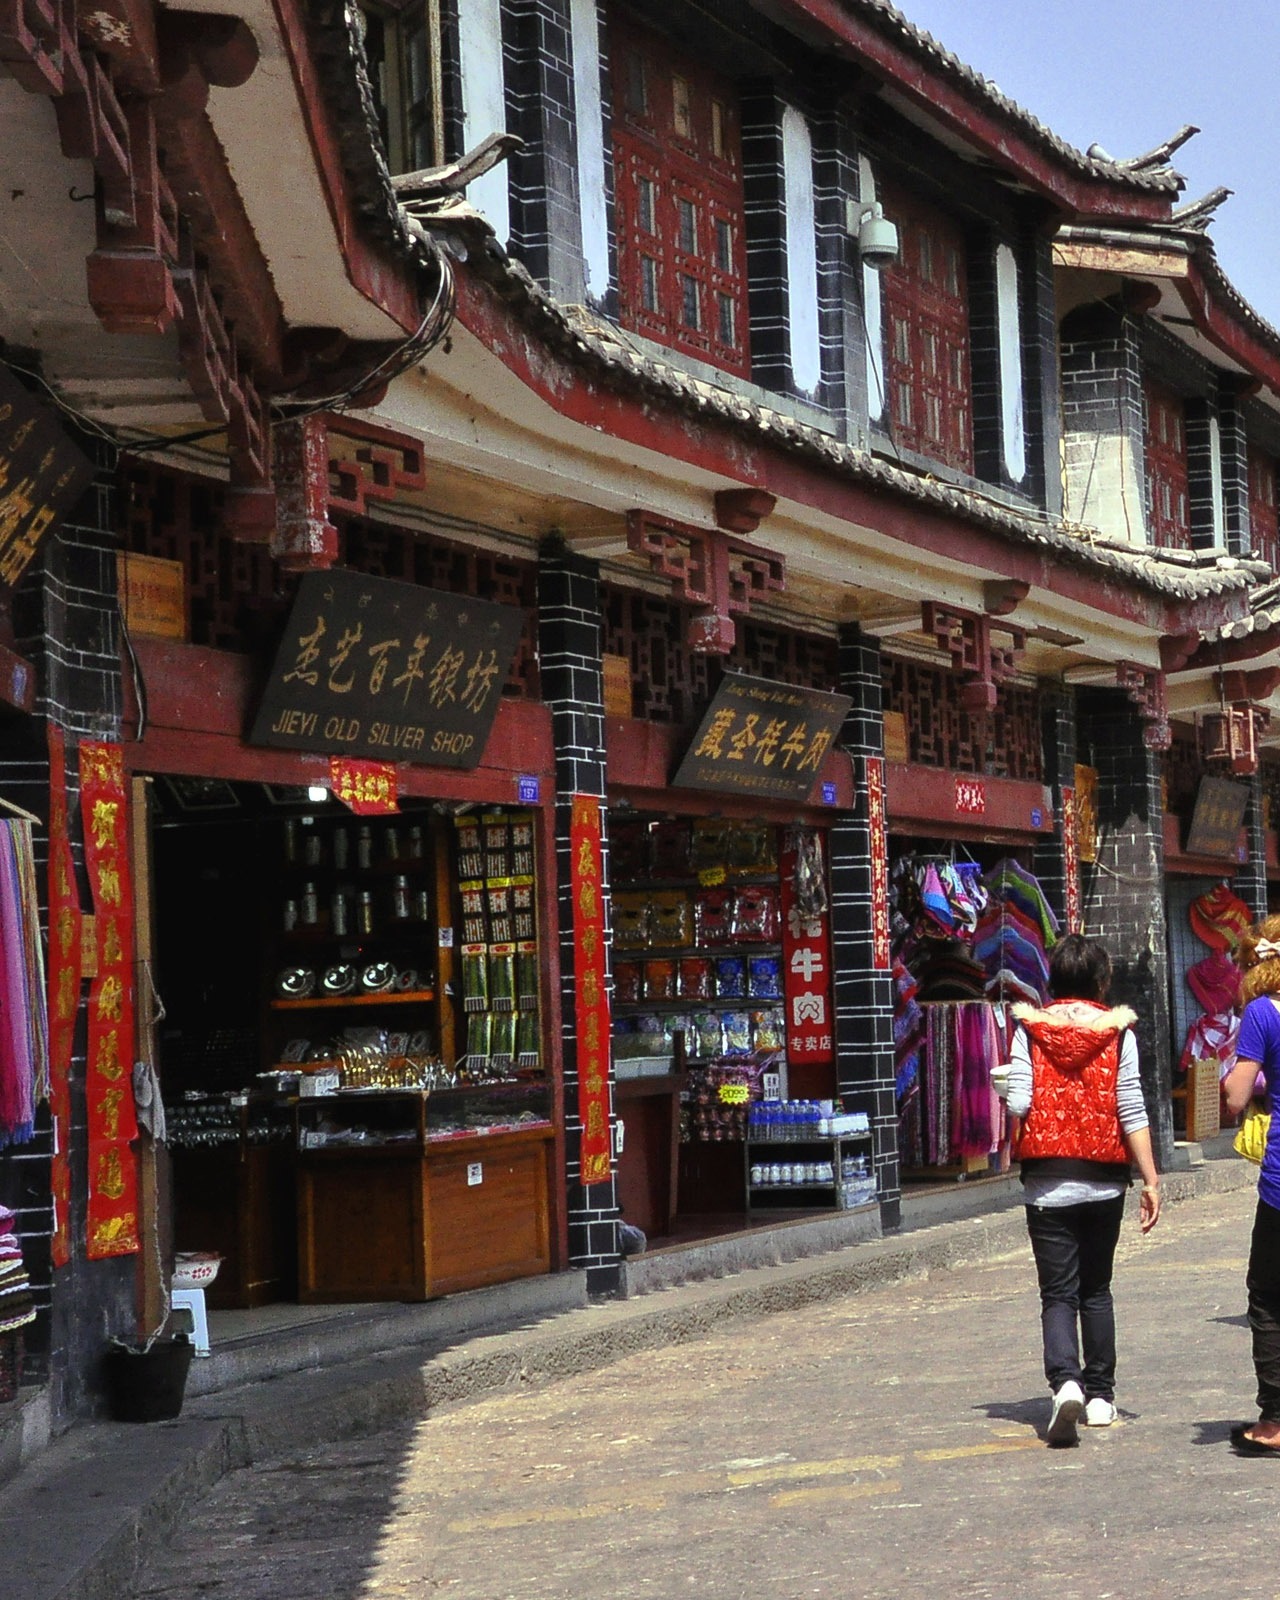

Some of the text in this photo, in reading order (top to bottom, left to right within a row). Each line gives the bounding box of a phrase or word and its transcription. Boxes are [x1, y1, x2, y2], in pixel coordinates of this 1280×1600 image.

[272, 709, 475, 755] JIEYI OLD SILVER SHOP
[790, 1035, 832, 1051] 专卖店
